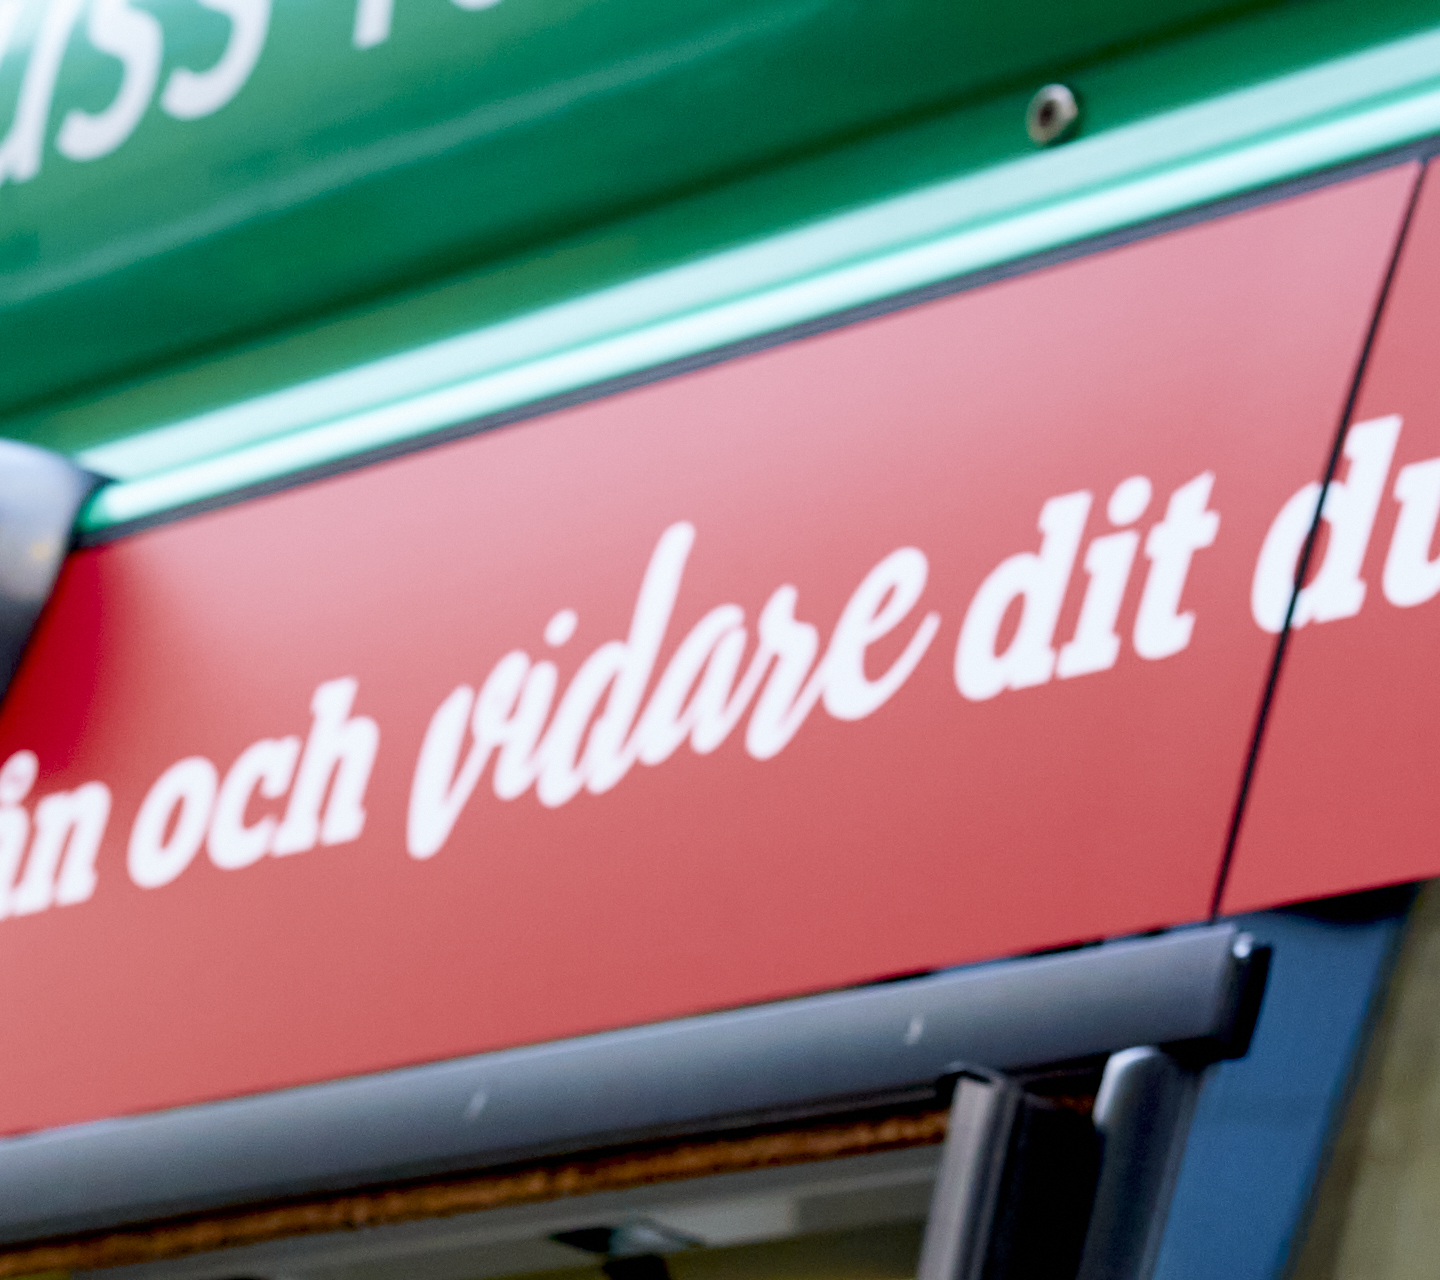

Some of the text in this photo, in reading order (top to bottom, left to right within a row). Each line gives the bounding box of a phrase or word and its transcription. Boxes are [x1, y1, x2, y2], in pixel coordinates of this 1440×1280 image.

[128, 678, 378, 887] och
[408, 522, 938, 858] vidare
[954, 474, 1220, 699] dit
